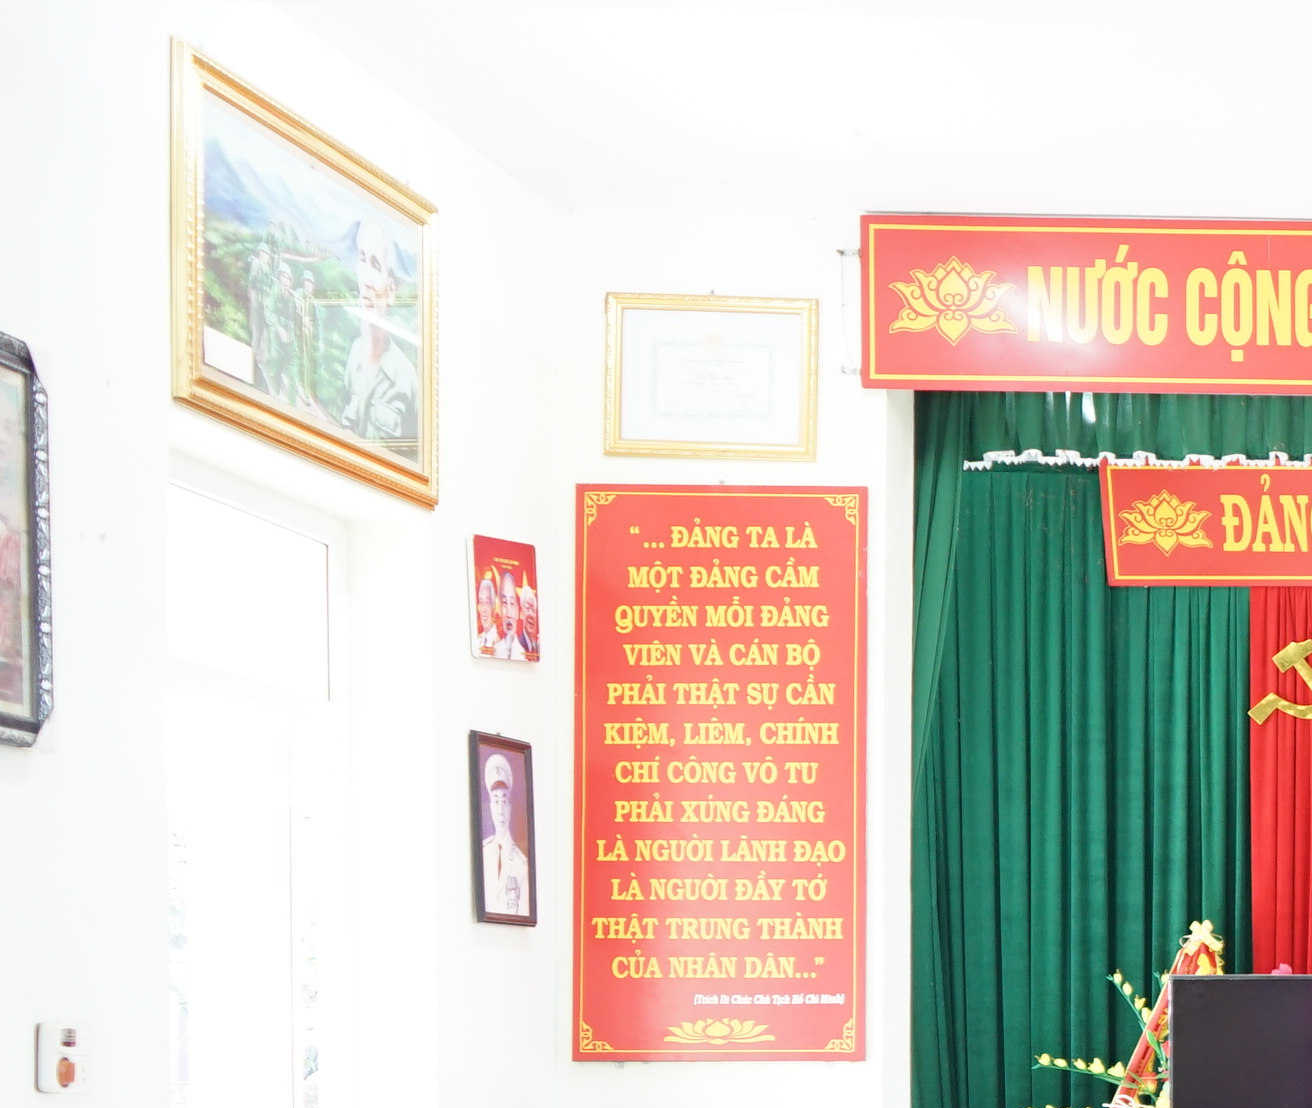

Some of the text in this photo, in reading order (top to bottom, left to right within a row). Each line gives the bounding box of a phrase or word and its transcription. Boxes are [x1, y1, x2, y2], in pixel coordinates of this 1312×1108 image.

[671, 518, 739, 548] ĐẢNG
[746, 527, 779, 548] TA
[785, 522, 817, 548] LÀ
[628, 557, 819, 593] MỘT ĐẢNG CẦM
[615, 596, 829, 633] QUYỀN MỖI ĐẢNG
[623, 638, 820, 670] VIÊN VÀ CÁN BỘ
[607, 675, 666, 704] PHẢI
[673, 678, 740, 709] THẬT
[786, 674, 835, 705] CẦN
[760, 717, 839, 744] CHÍNH
[616, 756, 660, 783] CHÍ
[667, 756, 736, 783] CÔNG
[742, 756, 777, 784] VÔ
[615, 793, 674, 822] PHẢI
[757, 795, 825, 823] ĐÁNG
[597, 834, 629, 861] LÀ
[721, 835, 786, 861] LÃNH
[794, 840, 845, 866] ĐẠO
[611, 872, 644, 900] LÀ
[735, 871, 785, 900] ĐẦY
[792, 873, 827, 901] TỚ
[592, 912, 843, 943] THẬT TRUNG THÀNH
[612, 950, 663, 978] CỦA
[669, 952, 737, 978] NHÂN
